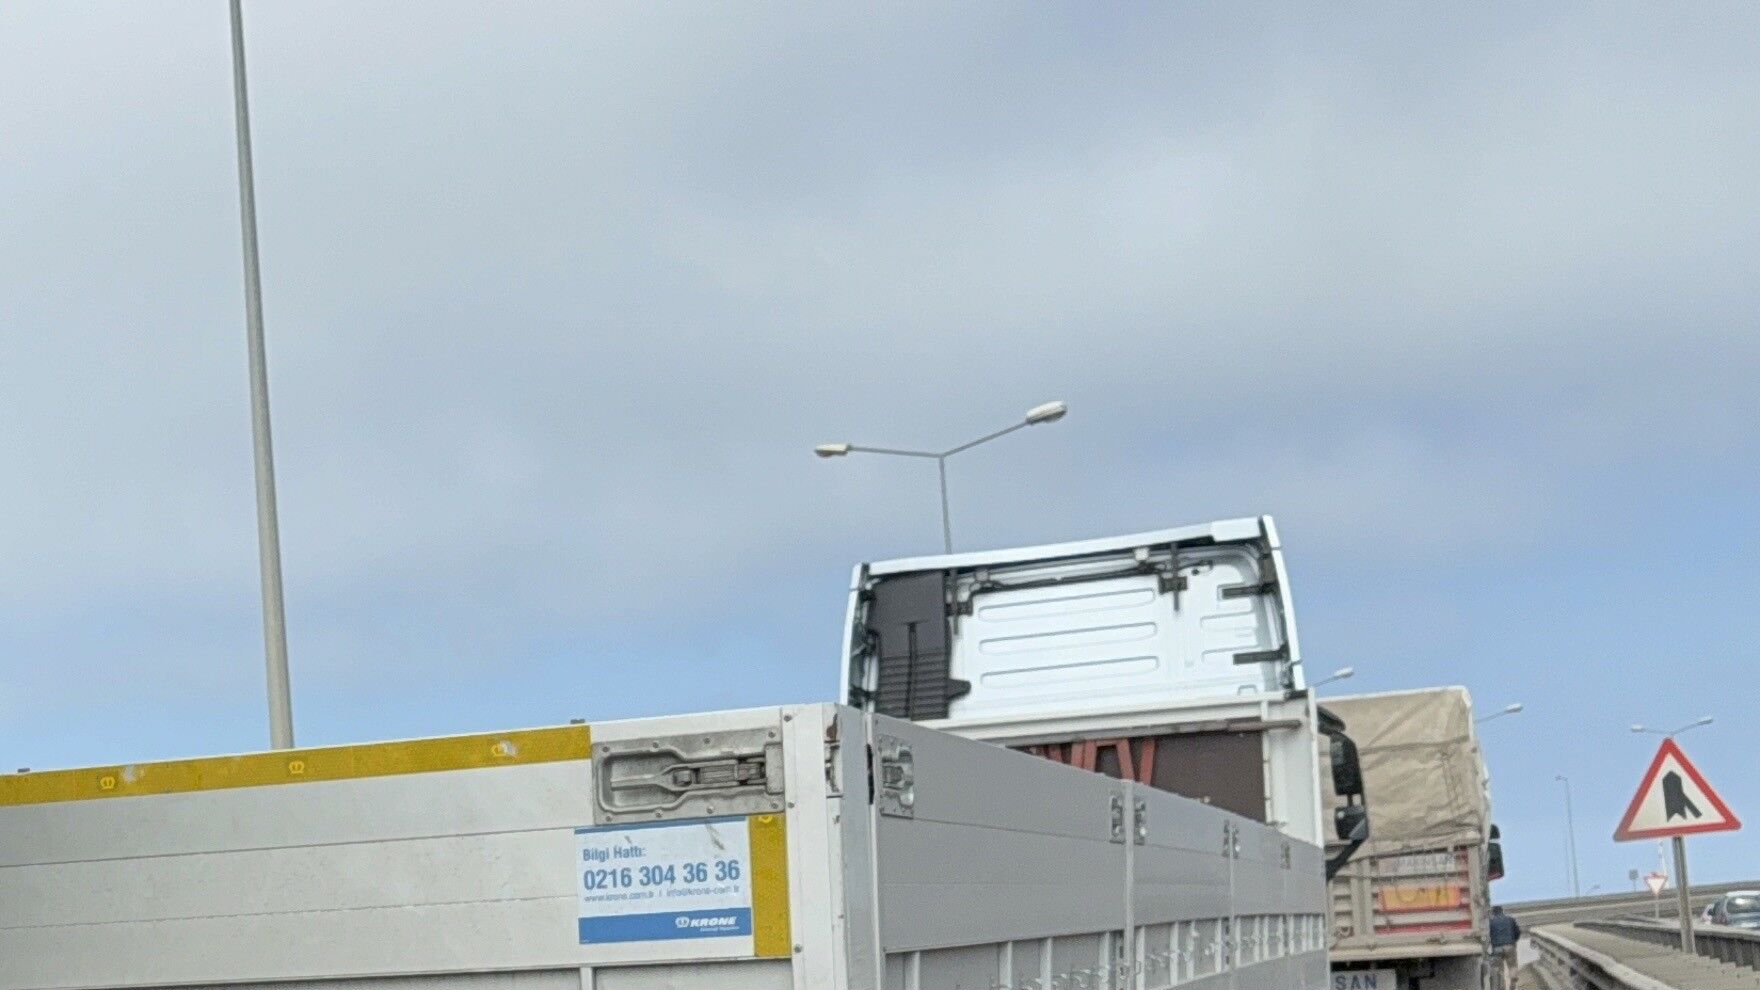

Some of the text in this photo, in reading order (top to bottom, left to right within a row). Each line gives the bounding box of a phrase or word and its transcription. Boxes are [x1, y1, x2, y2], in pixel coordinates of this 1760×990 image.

[583, 848, 609, 862] Bilgi
[584, 860, 740, 890] 0216 304 36 36
[690, 916, 737, 927] KRONE
